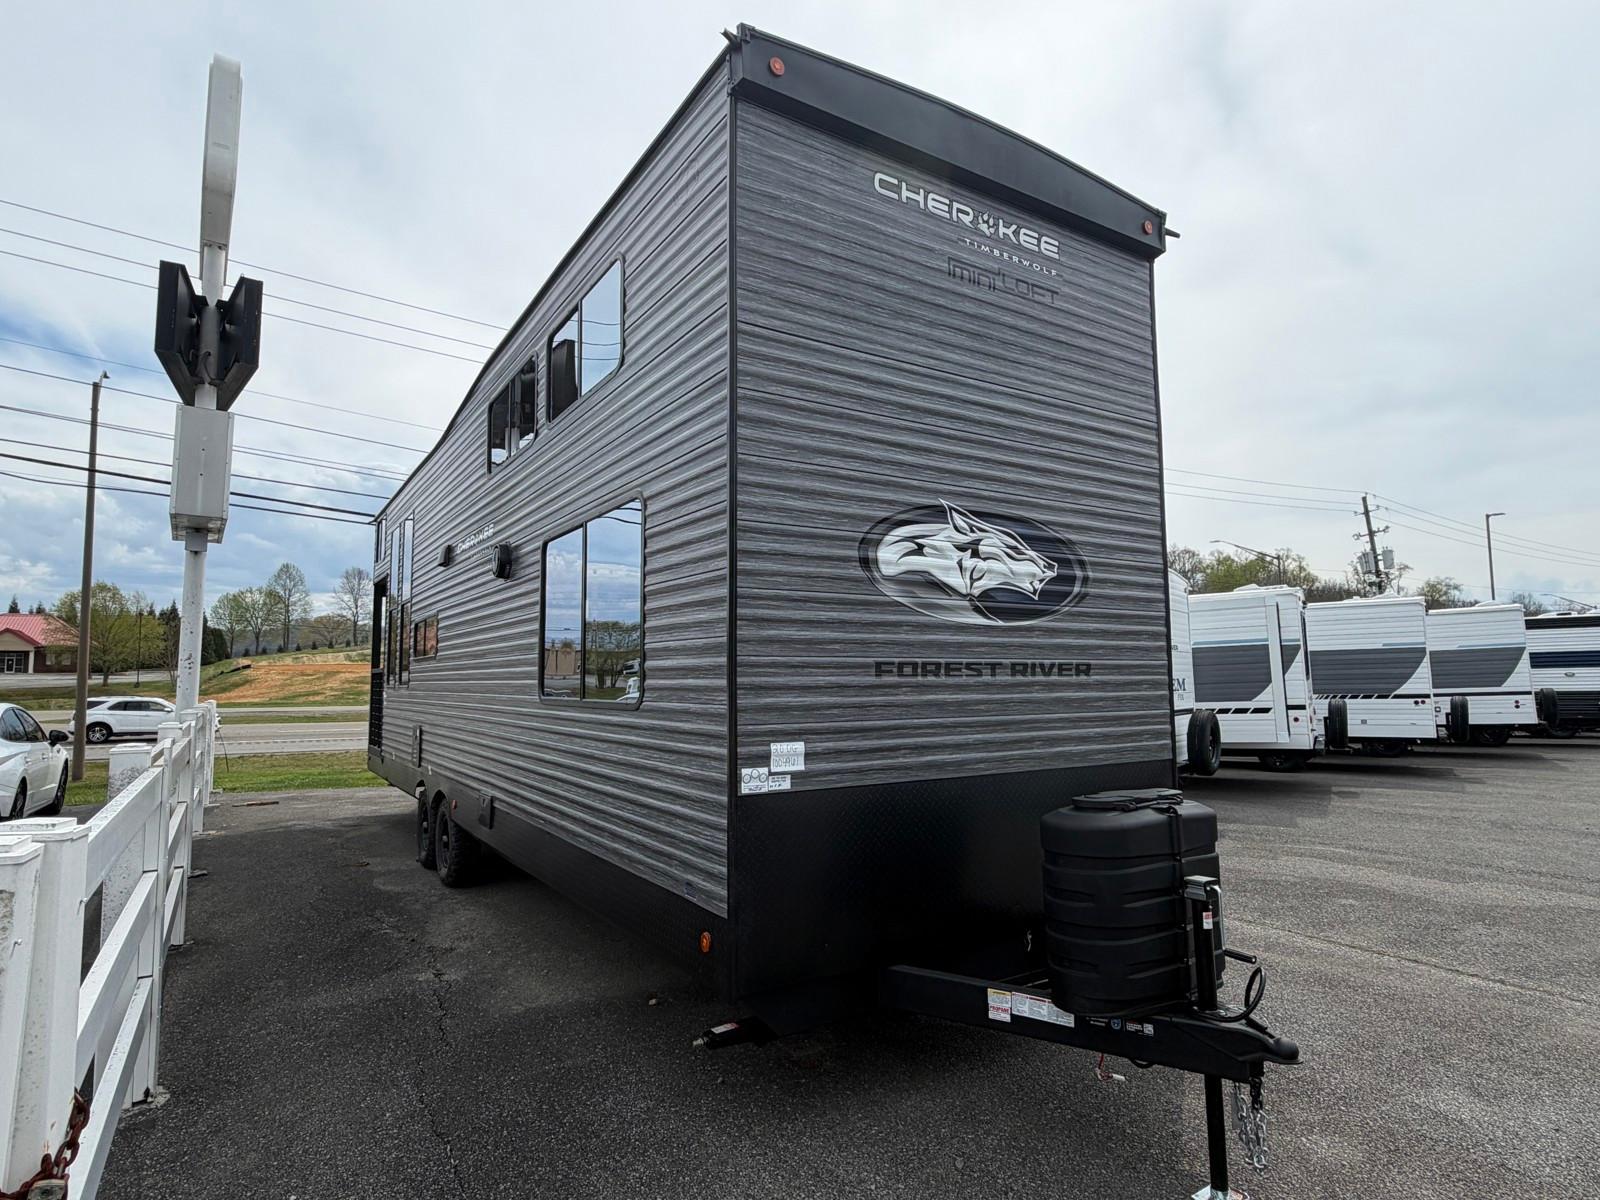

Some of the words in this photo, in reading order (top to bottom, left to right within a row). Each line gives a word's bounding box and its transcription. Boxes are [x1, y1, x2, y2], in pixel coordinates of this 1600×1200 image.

[964, 238, 1058, 277] TIMBERWOLF
[874, 661, 1003, 678] FOREST
[1010, 661, 1092, 678] RIVER
